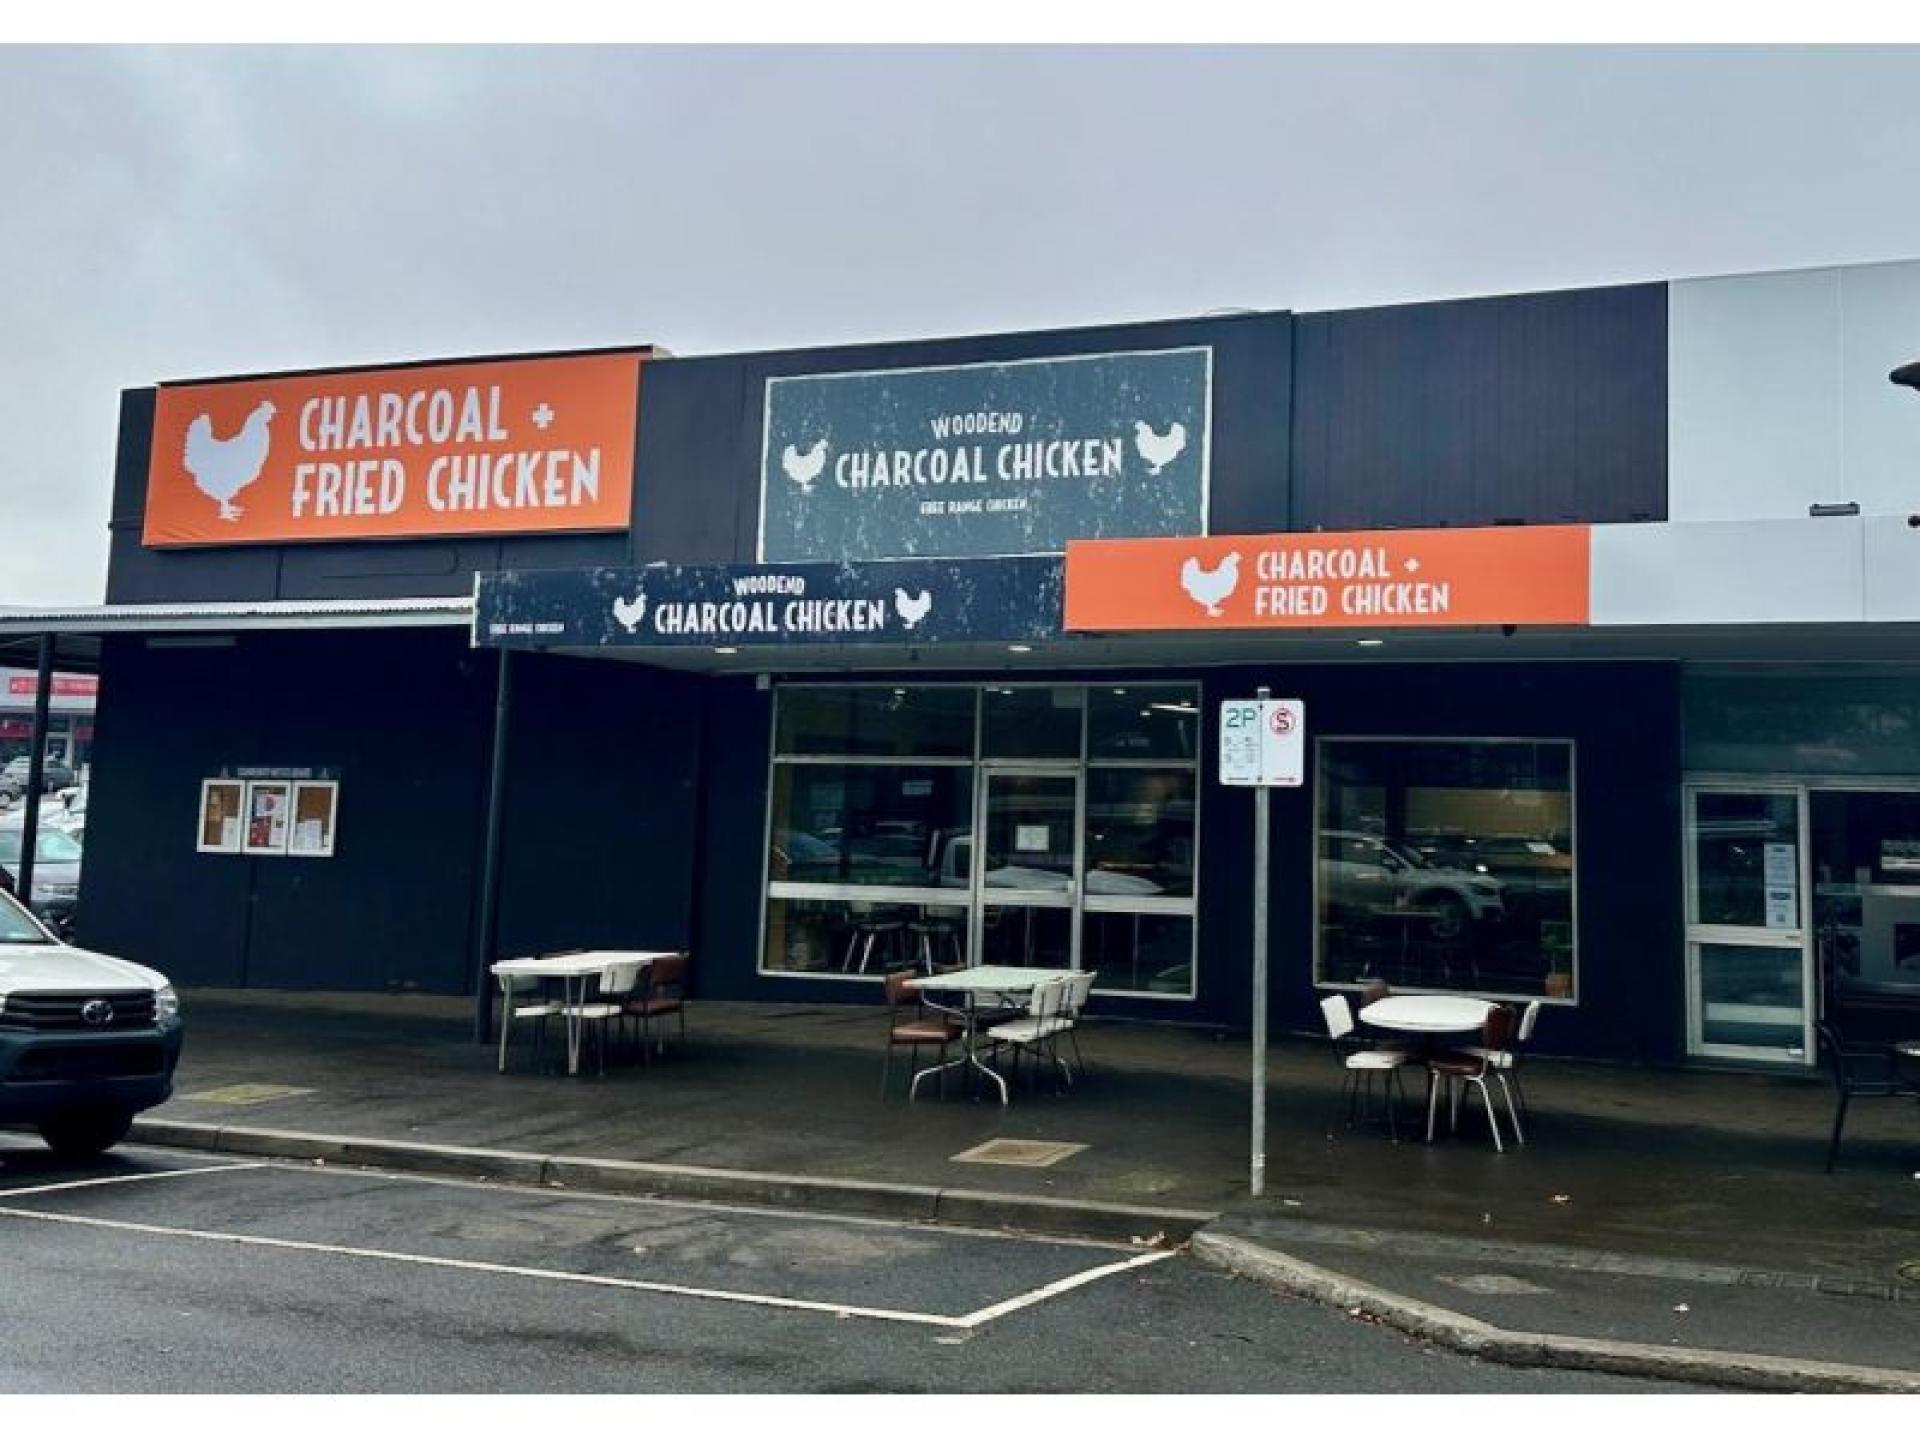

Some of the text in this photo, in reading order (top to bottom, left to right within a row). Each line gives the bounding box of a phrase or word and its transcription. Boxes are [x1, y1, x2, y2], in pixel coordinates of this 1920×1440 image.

[299, 385, 508, 451] CHARCOAL
[931, 412, 1022, 439] WOODEND
[835, 439, 1122, 488] CHARCOAL CHICKEN
[292, 448, 601, 518] FRIED CHICKEN
[1257, 548, 1390, 580] CHARCOAL
[732, 575, 805, 596] WOODEND
[1255, 583, 1449, 616] FRIED CHICKEN
[654, 599, 885, 633] CHARCOAL CHICKEN
[1225, 707, 1256, 728] 2P
